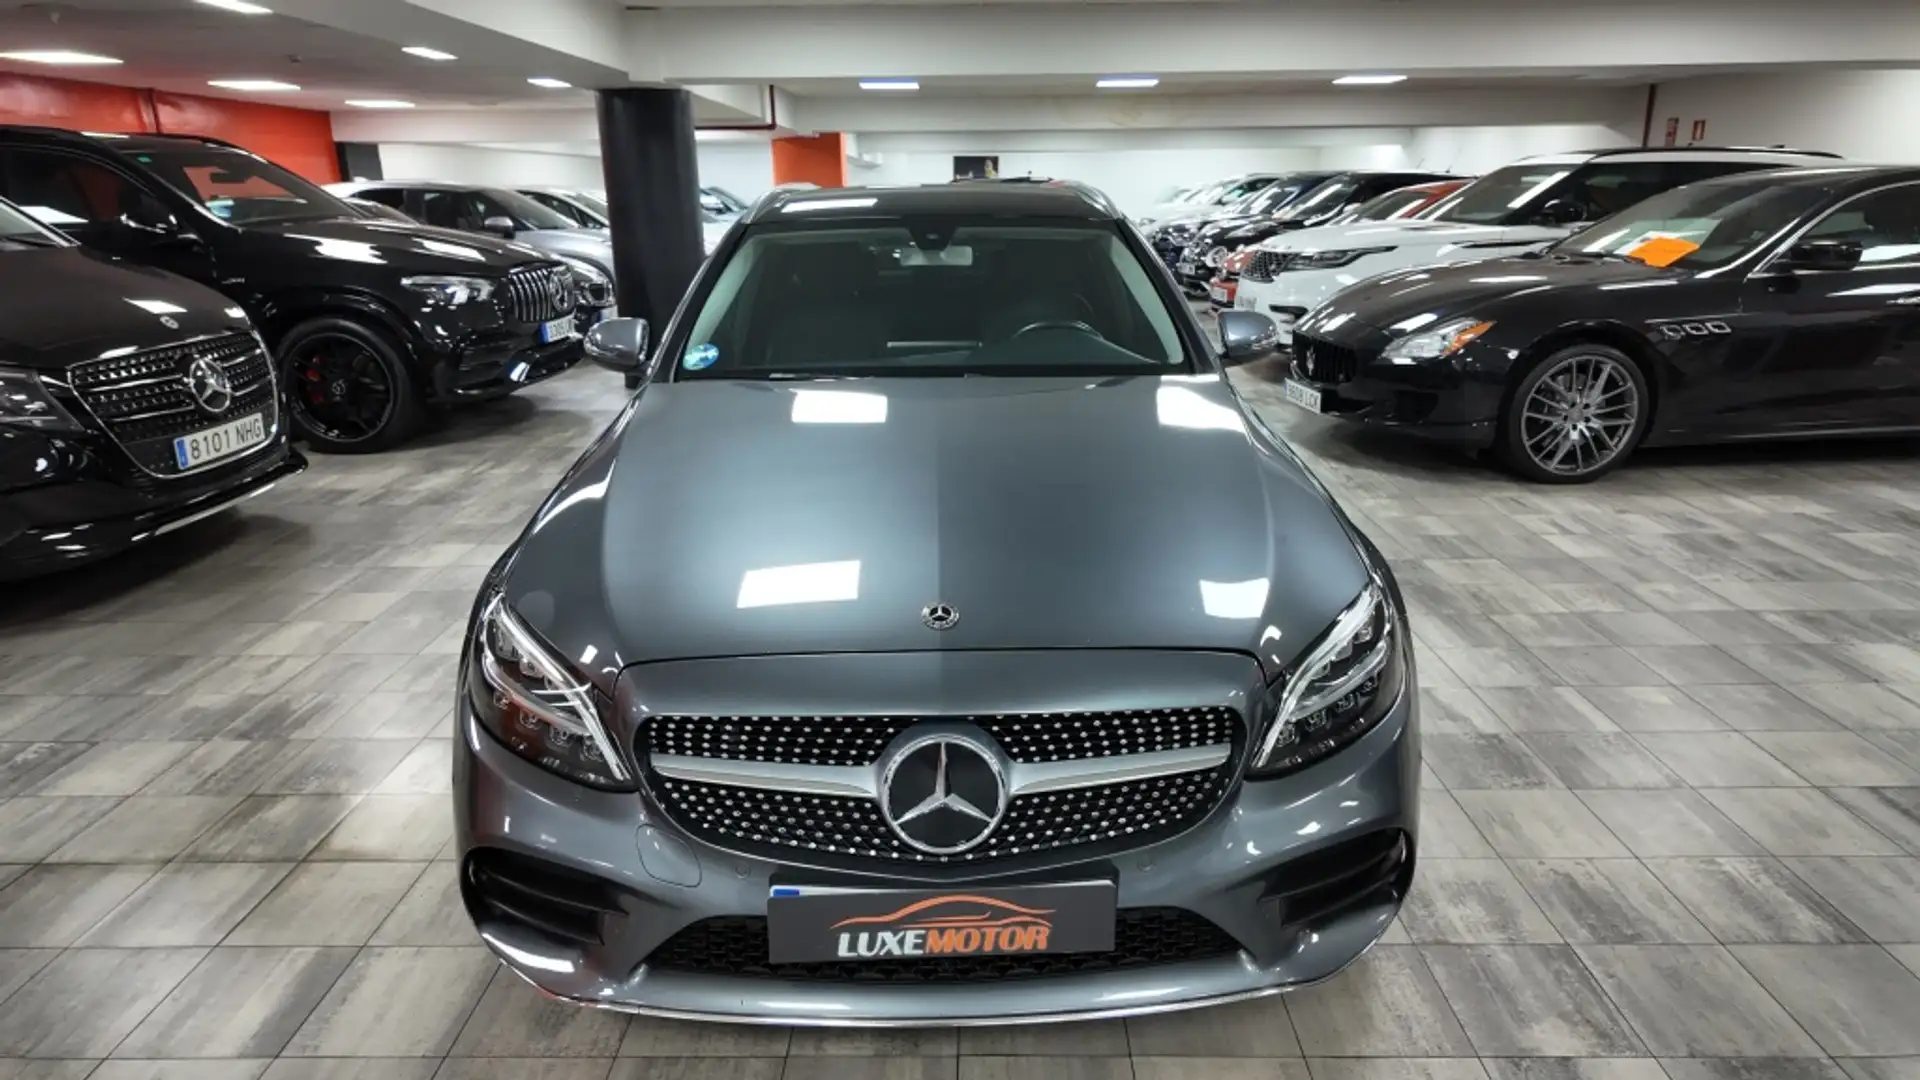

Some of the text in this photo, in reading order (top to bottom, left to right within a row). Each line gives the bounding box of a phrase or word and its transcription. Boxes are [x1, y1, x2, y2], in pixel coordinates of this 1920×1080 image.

[190, 418, 262, 460] 8101 NHG
[837, 926, 1050, 957] LUXEMOTOR
